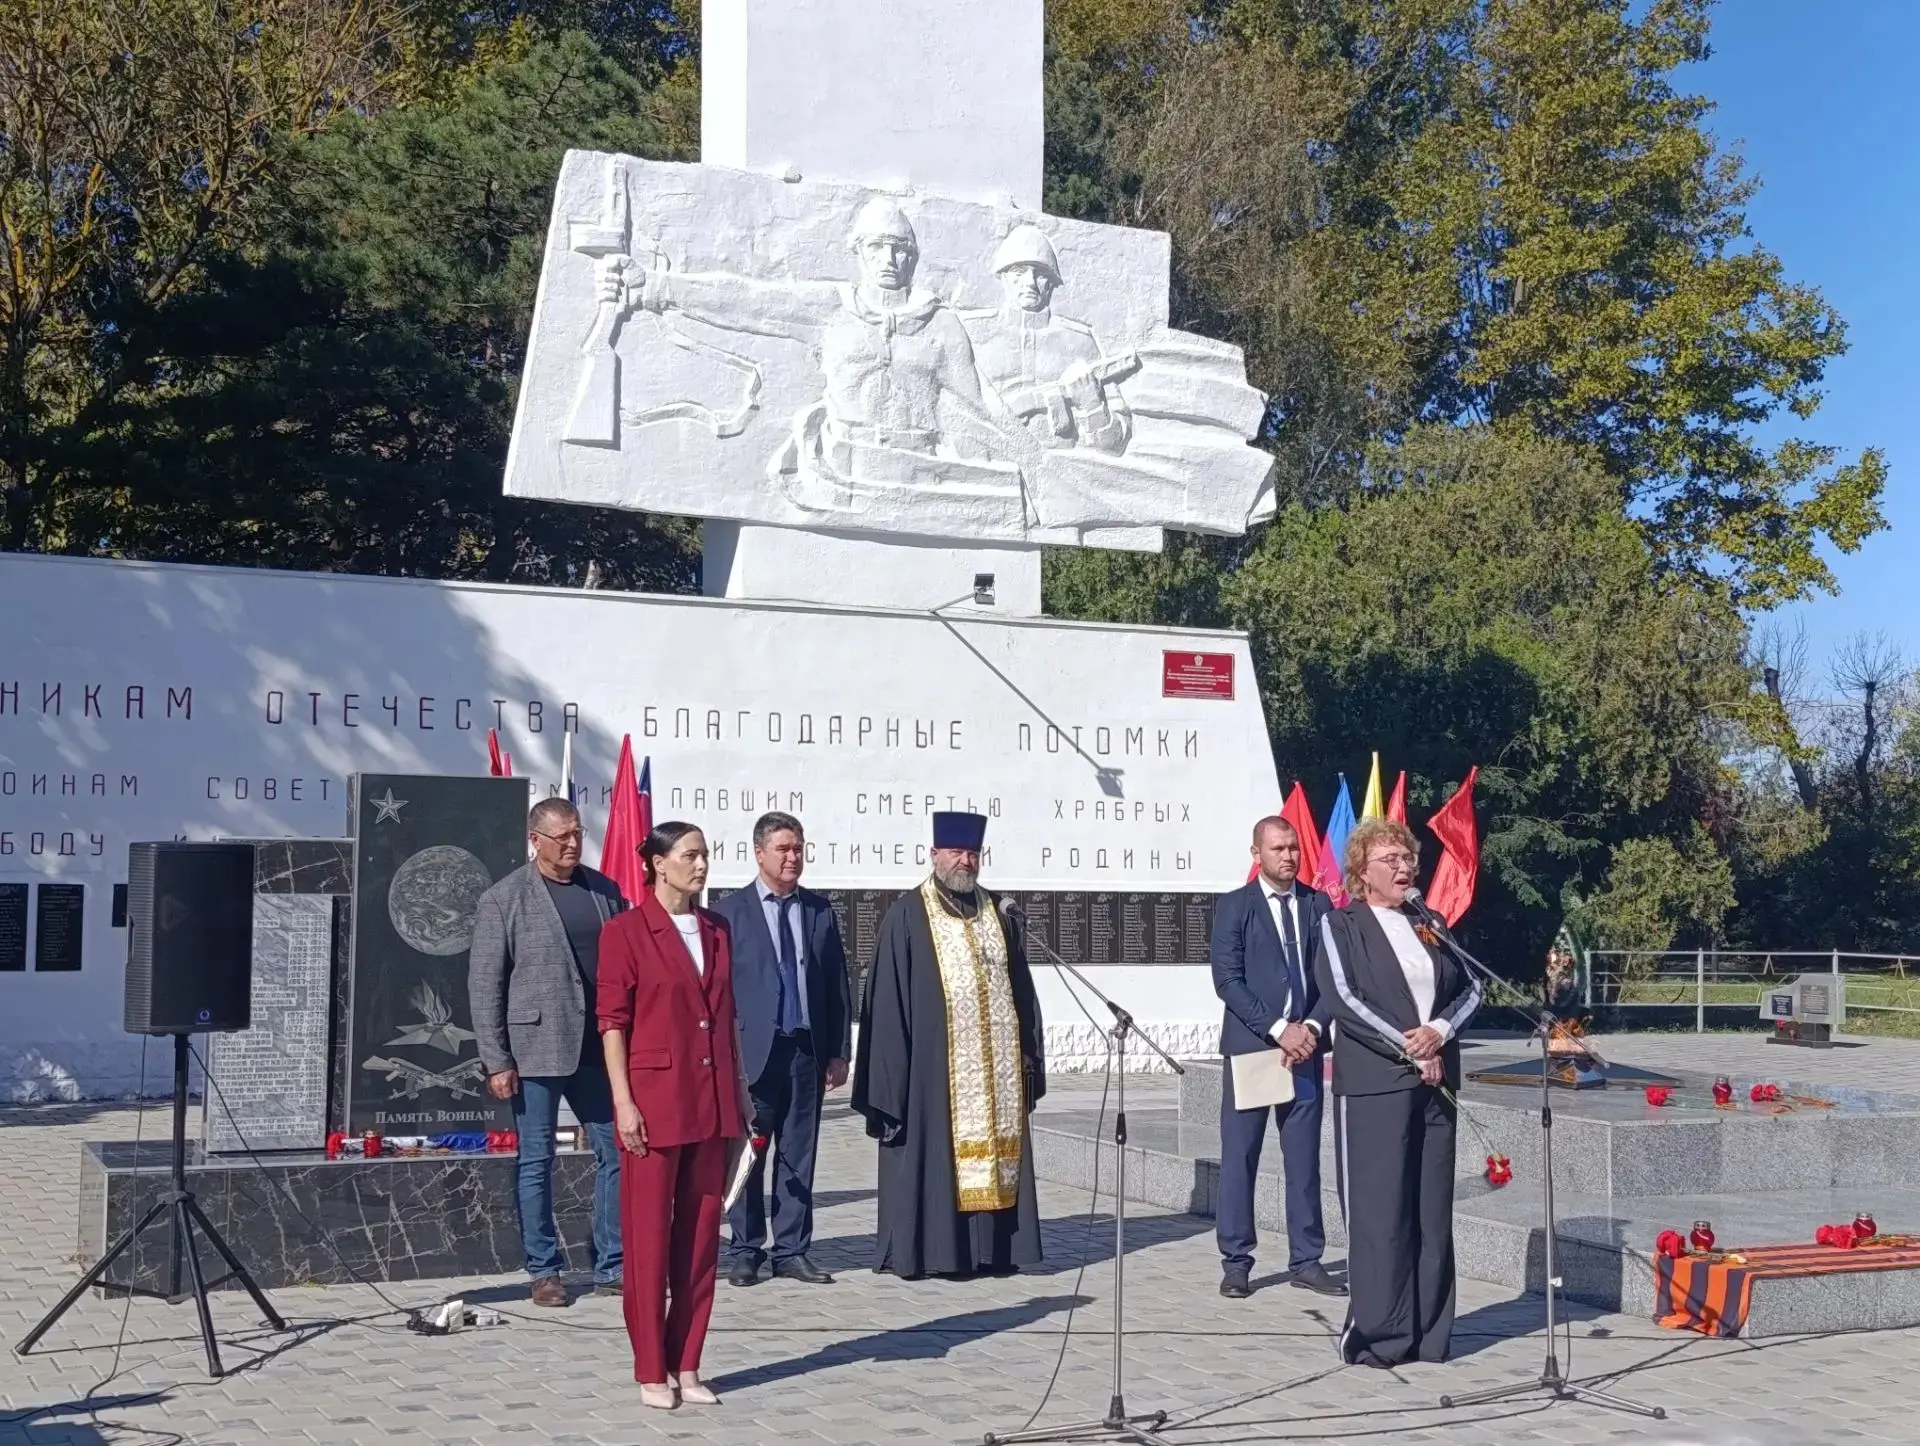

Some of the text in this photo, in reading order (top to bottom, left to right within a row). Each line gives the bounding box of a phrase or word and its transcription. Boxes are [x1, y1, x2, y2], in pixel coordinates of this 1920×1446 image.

[0, 681, 1198, 758] НИКАМ ОТЕЧЕСТВА БЛАГОДАРНЫЕ ПОТОМКИ
[2, 771, 1191, 823] ОИНАМ СОВЕТ РМИИ ПАВШИМ СМЕРТЬЮ ХРАБРЫХ
[0, 831, 104, 857] БОДУ
[1041, 847, 1192, 870] РОДИНЫ
